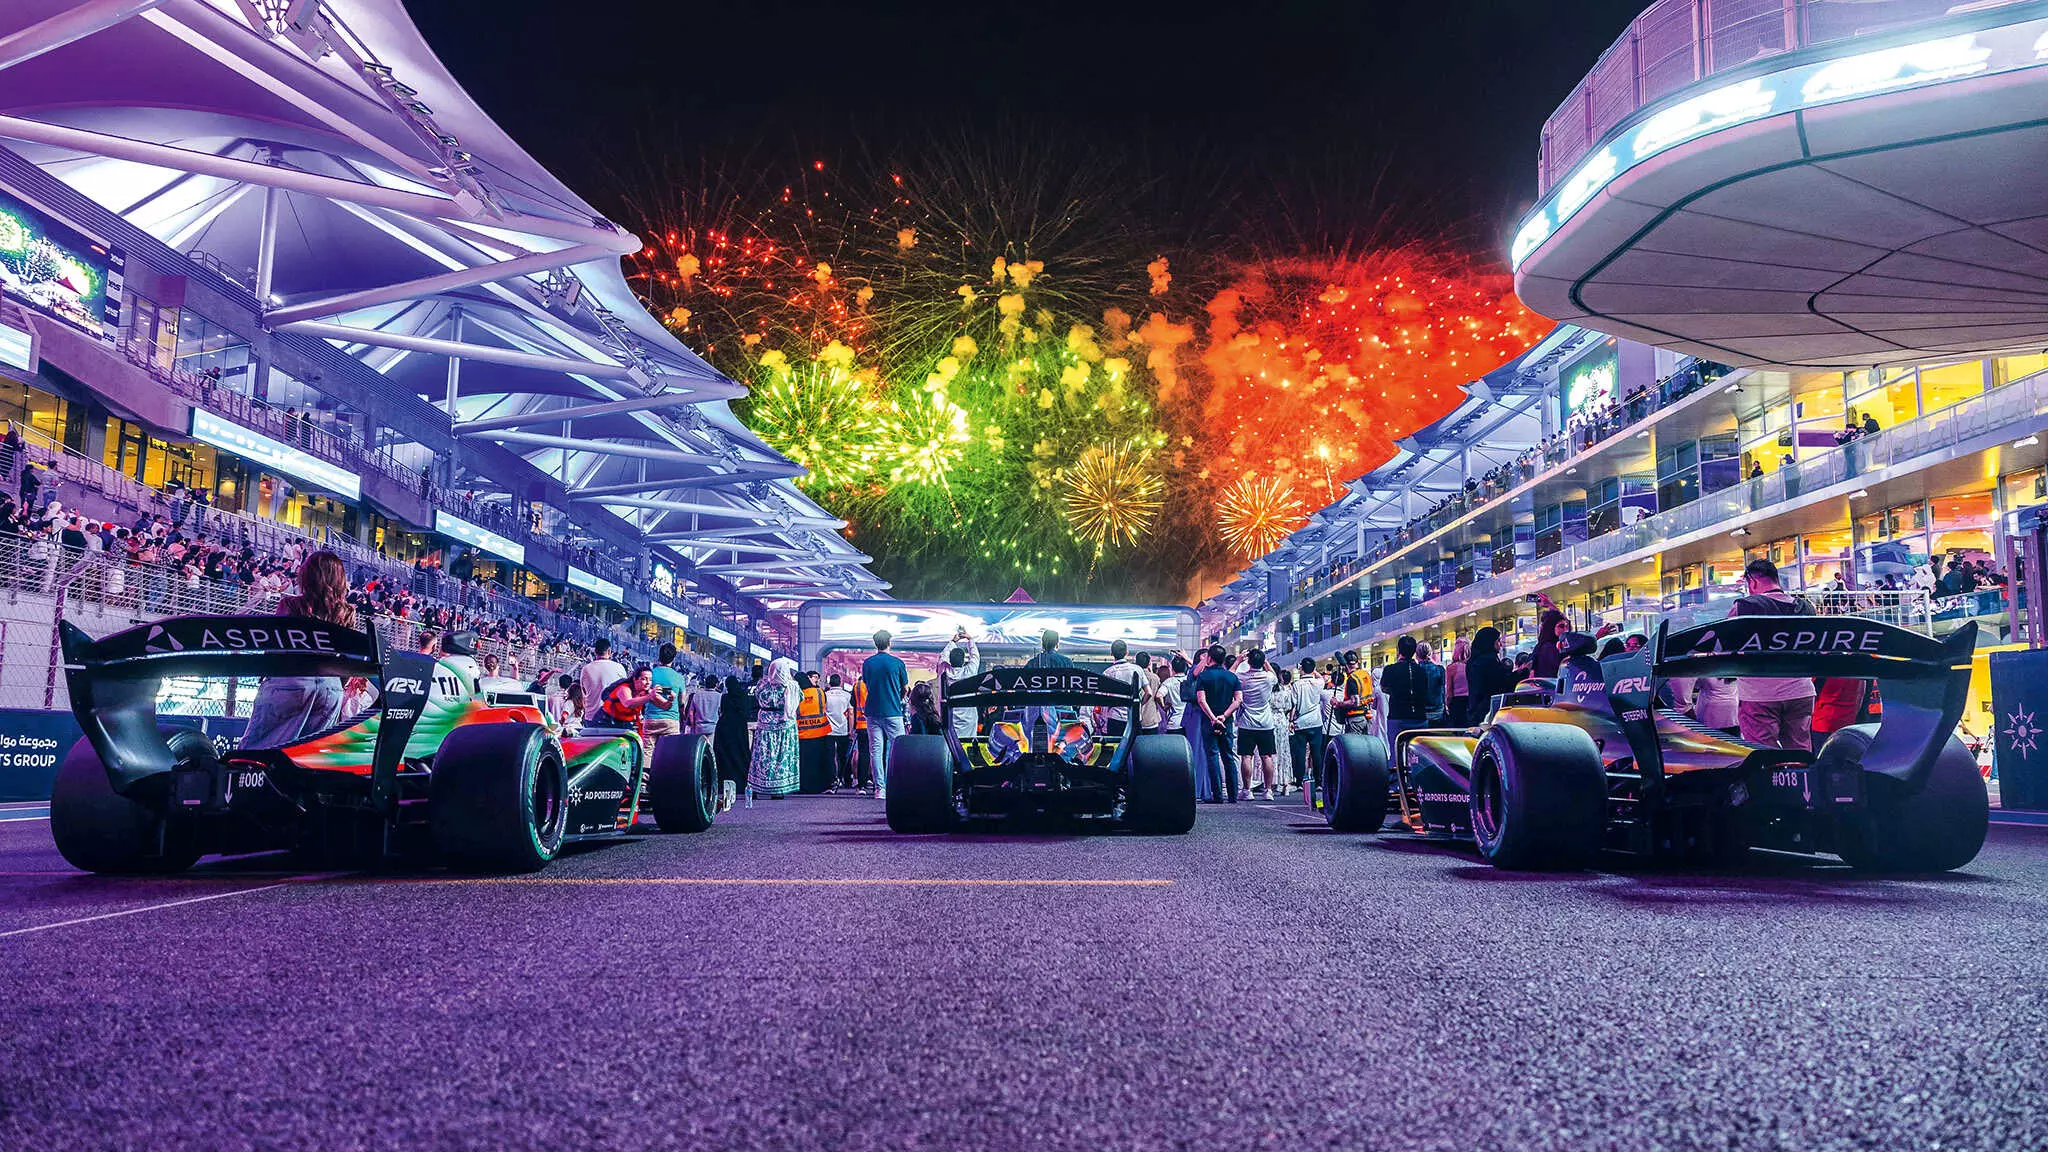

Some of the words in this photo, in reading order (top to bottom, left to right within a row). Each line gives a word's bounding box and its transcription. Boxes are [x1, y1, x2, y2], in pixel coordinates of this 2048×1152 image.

[110, 253, 125, 266] YAS
[108, 279, 121, 291] YAS
[104, 304, 119, 317] YAS
[201, 628, 335, 650] ASPIRE
[1739, 630, 1884, 651] ASPIRE
[384, 676, 425, 695] A2RL
[1012, 675, 1099, 690] ASPIRE
[1572, 682, 1605, 694] movyon
[1611, 675, 1651, 695] A2RL
[18, 734, 58, 750] مجموعة
[13, 753, 56, 767] GROUP
[238, 772, 264, 788] #008
[1771, 771, 1798, 787] #018
[584, 791, 593, 800] AD
[594, 791, 610, 800] PORTS
